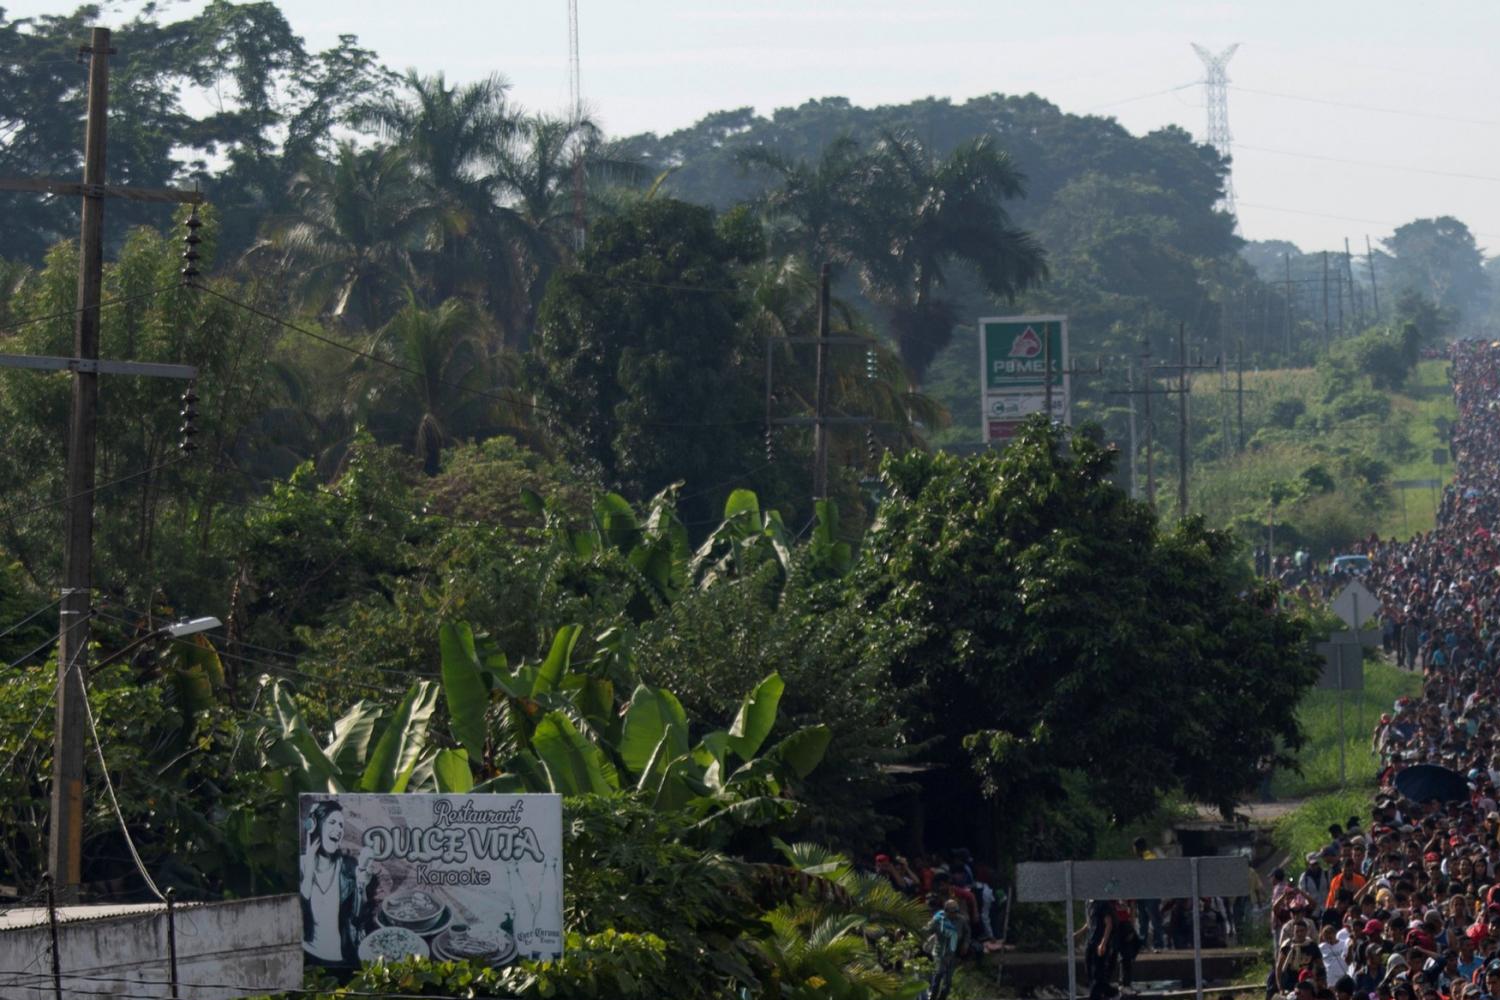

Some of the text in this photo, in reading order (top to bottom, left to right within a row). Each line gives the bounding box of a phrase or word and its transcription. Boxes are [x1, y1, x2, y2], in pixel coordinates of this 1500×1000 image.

[433, 799, 524, 827] Restaurant
[362, 826, 545, 863] DULCE VITA
[416, 865, 491, 886] Karaoke
